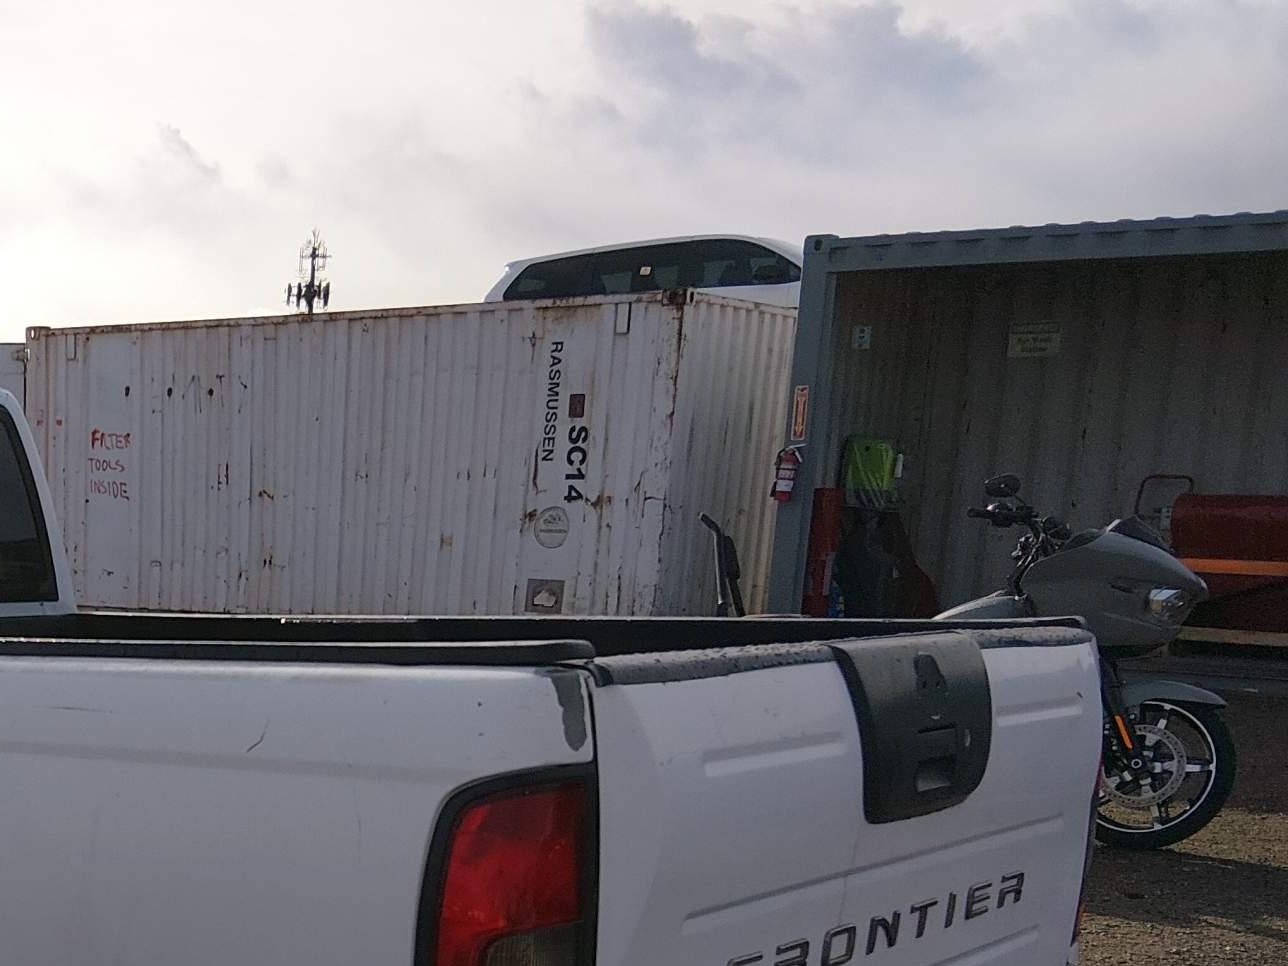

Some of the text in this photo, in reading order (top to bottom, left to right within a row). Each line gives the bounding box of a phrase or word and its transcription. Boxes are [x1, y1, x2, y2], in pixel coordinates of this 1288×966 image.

[541, 340, 564, 463] RASMUSSEN
[90, 427, 131, 450] FILTER
[88, 457, 125, 473] TOOLS
[563, 424, 588, 504] SC14
[90, 479, 130, 501] INSIDE
